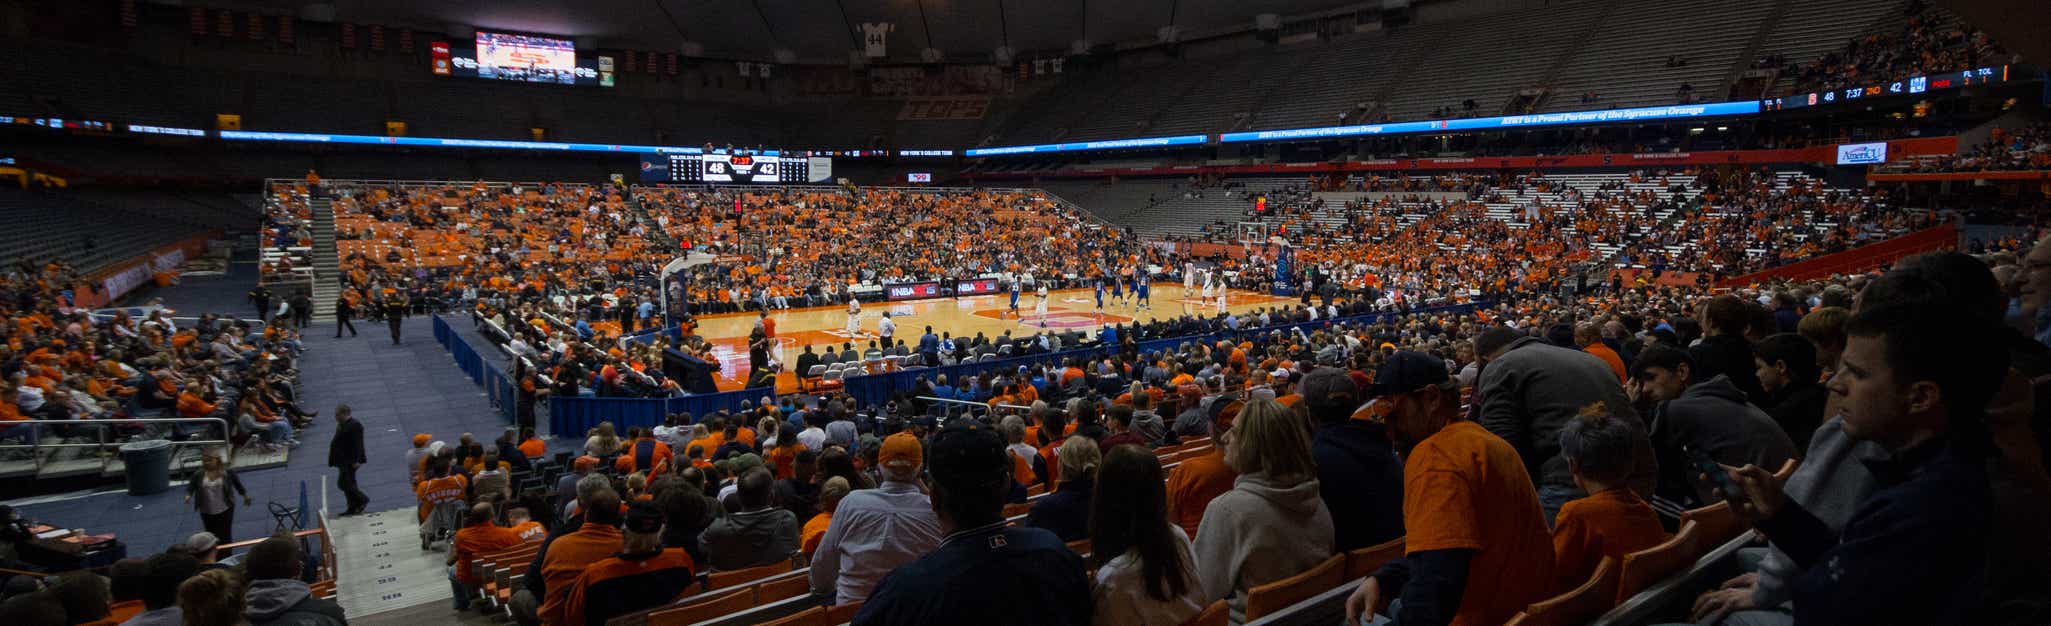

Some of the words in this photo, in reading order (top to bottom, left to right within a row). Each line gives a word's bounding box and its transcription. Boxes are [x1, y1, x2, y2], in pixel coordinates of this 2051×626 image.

[867, 34, 882, 46] 44
[1823, 92, 1834, 102] 48
[1846, 88, 1862, 99] 7:37
[1890, 82, 1902, 92] 42
[709, 162, 724, 174] 48
[760, 163, 774, 175] 42
